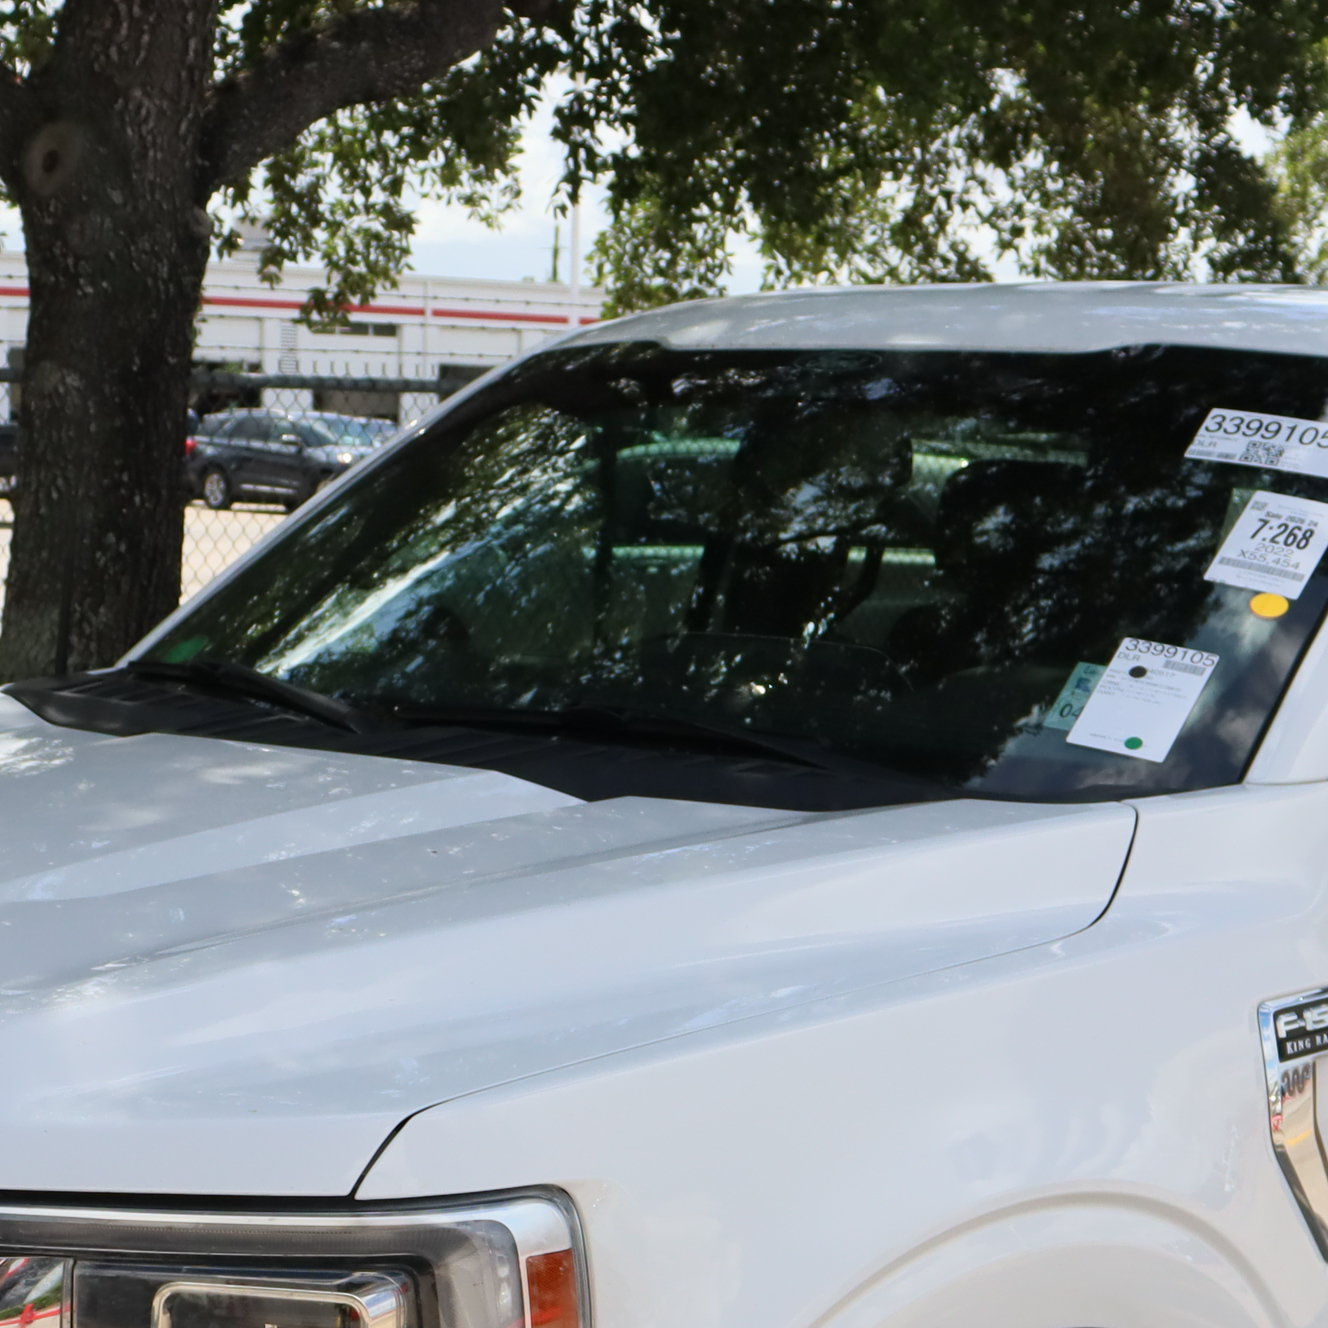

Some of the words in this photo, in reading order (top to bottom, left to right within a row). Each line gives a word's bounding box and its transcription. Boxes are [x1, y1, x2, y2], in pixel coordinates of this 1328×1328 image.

[1250, 518, 1315, 550] 7:268
[1255, 542, 1295, 558] 2022
[1125, 638, 1217, 667] 3399105
[1286, 1037, 1312, 1055] KING
